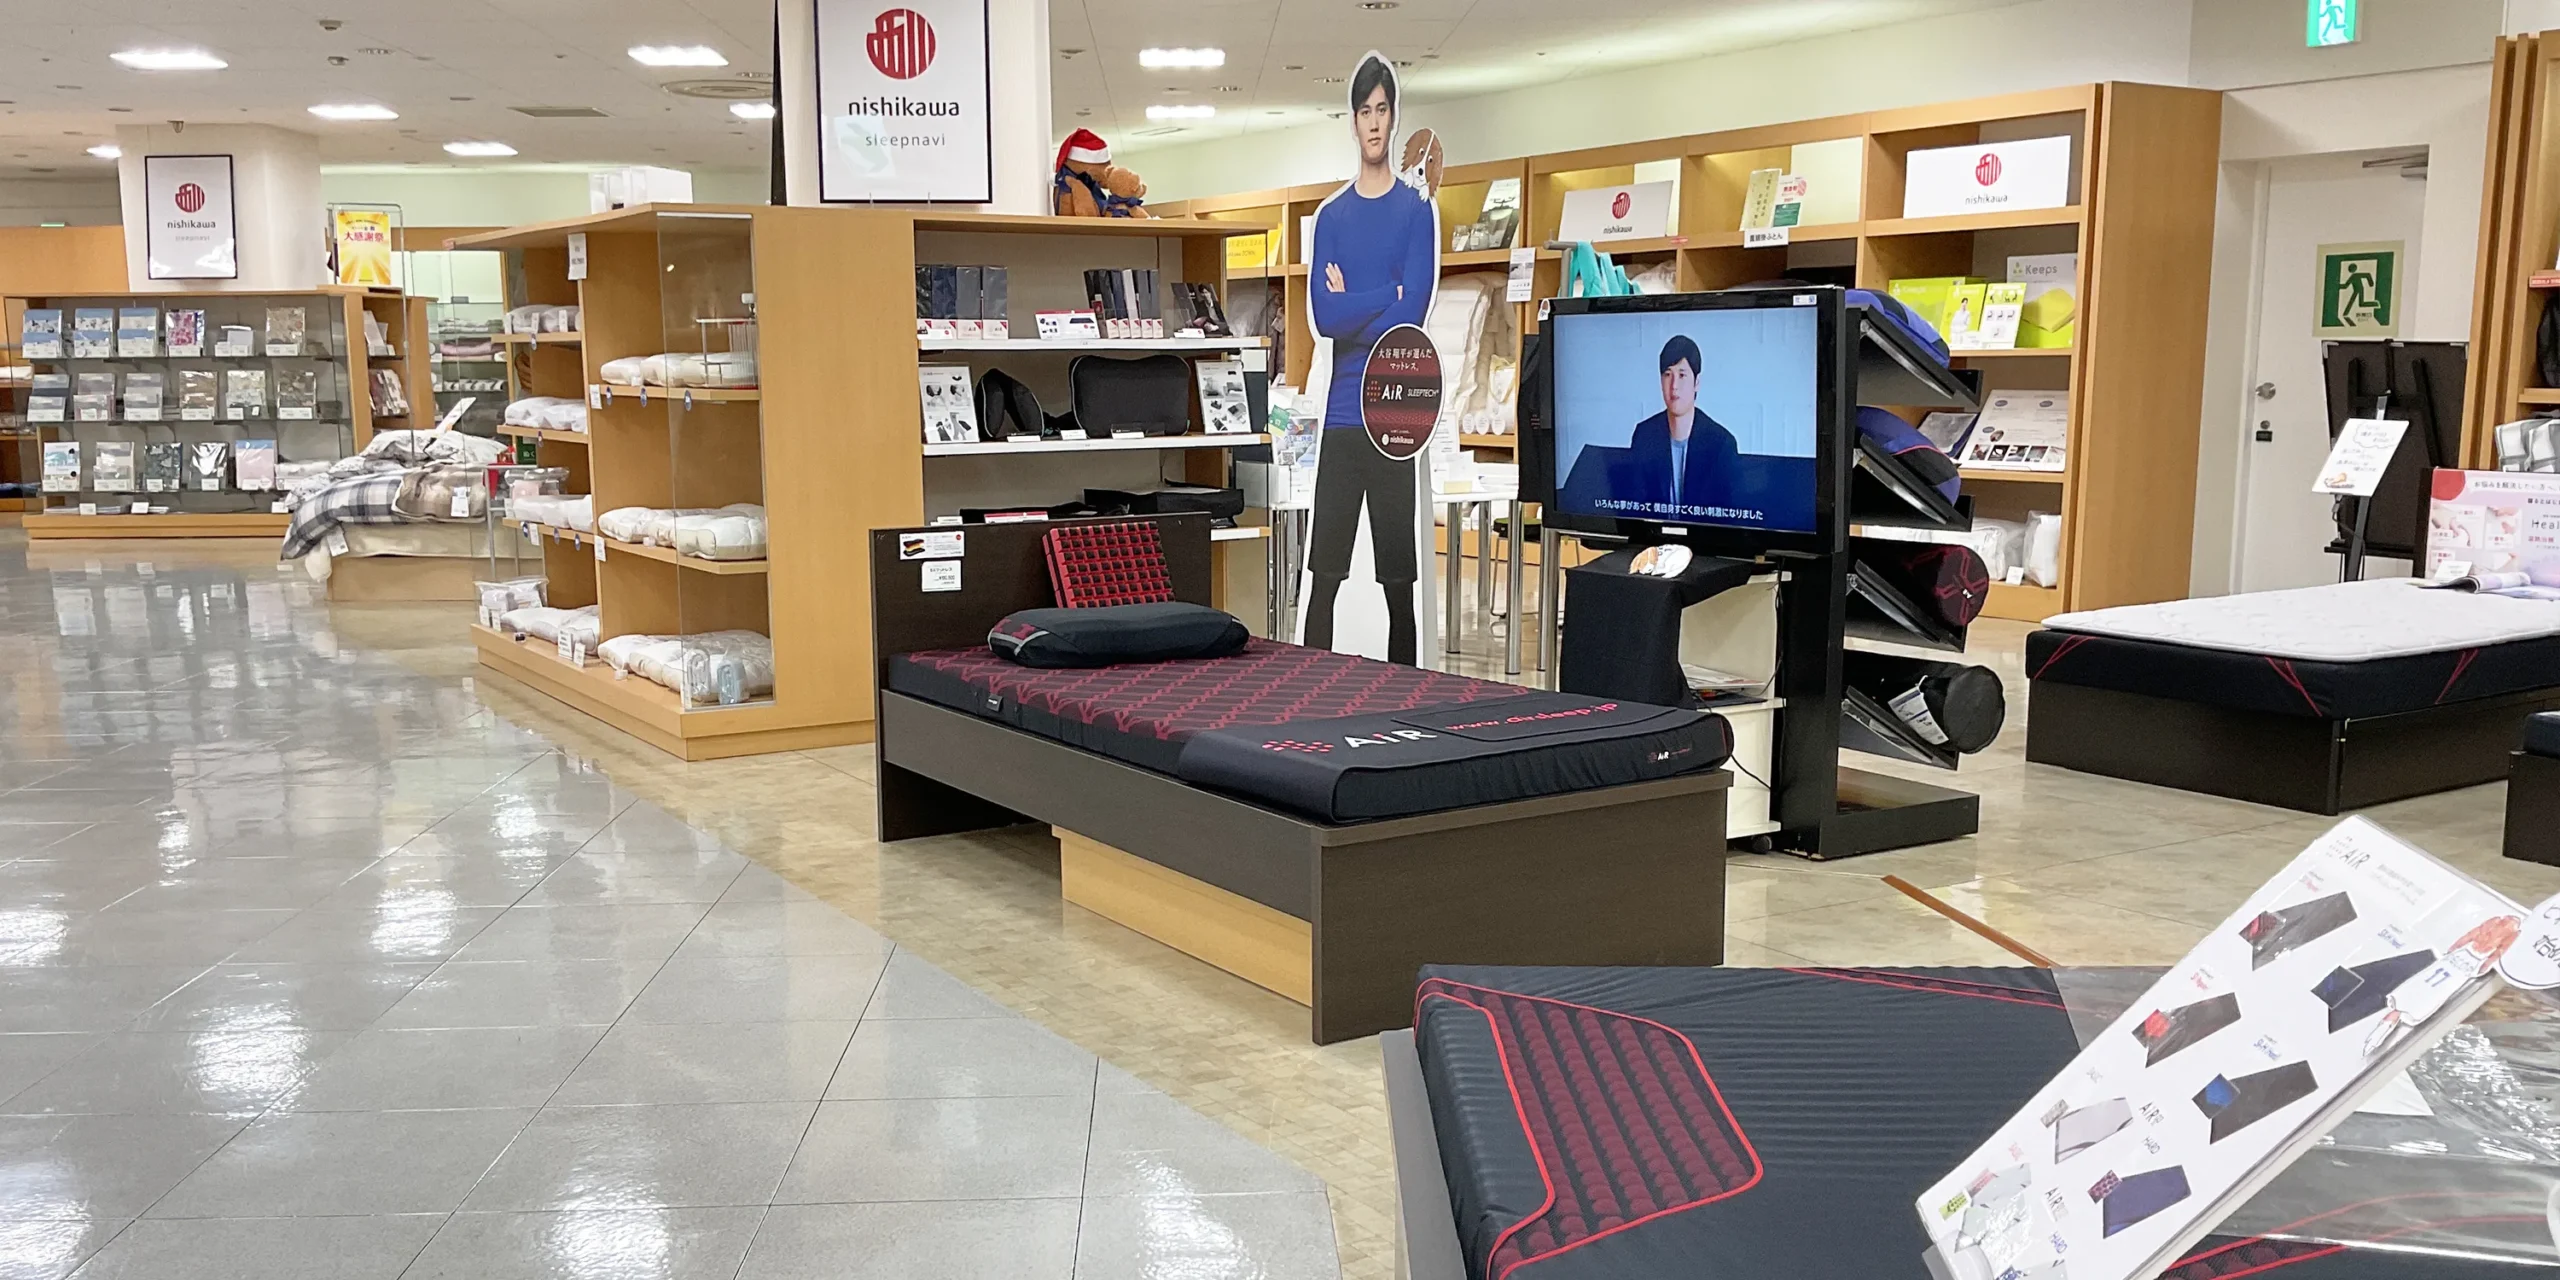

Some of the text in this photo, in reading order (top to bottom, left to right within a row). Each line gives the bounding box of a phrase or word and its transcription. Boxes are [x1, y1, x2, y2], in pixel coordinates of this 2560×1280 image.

[848, 97, 959, 117] nishikawa
[865, 133, 946, 149] sleepnavi
[1965, 194, 2008, 205] nishikawa
[167, 219, 216, 229] nishikawa
[2025, 264, 2058, 277] Keeps
[1378, 347, 1433, 359] 大谷翔平が選んだ
[1389, 361, 1419, 371] マットレス。
[1594, 498, 1652, 512] いろんな夢があって
[2424, 967, 2452, 988] 17
